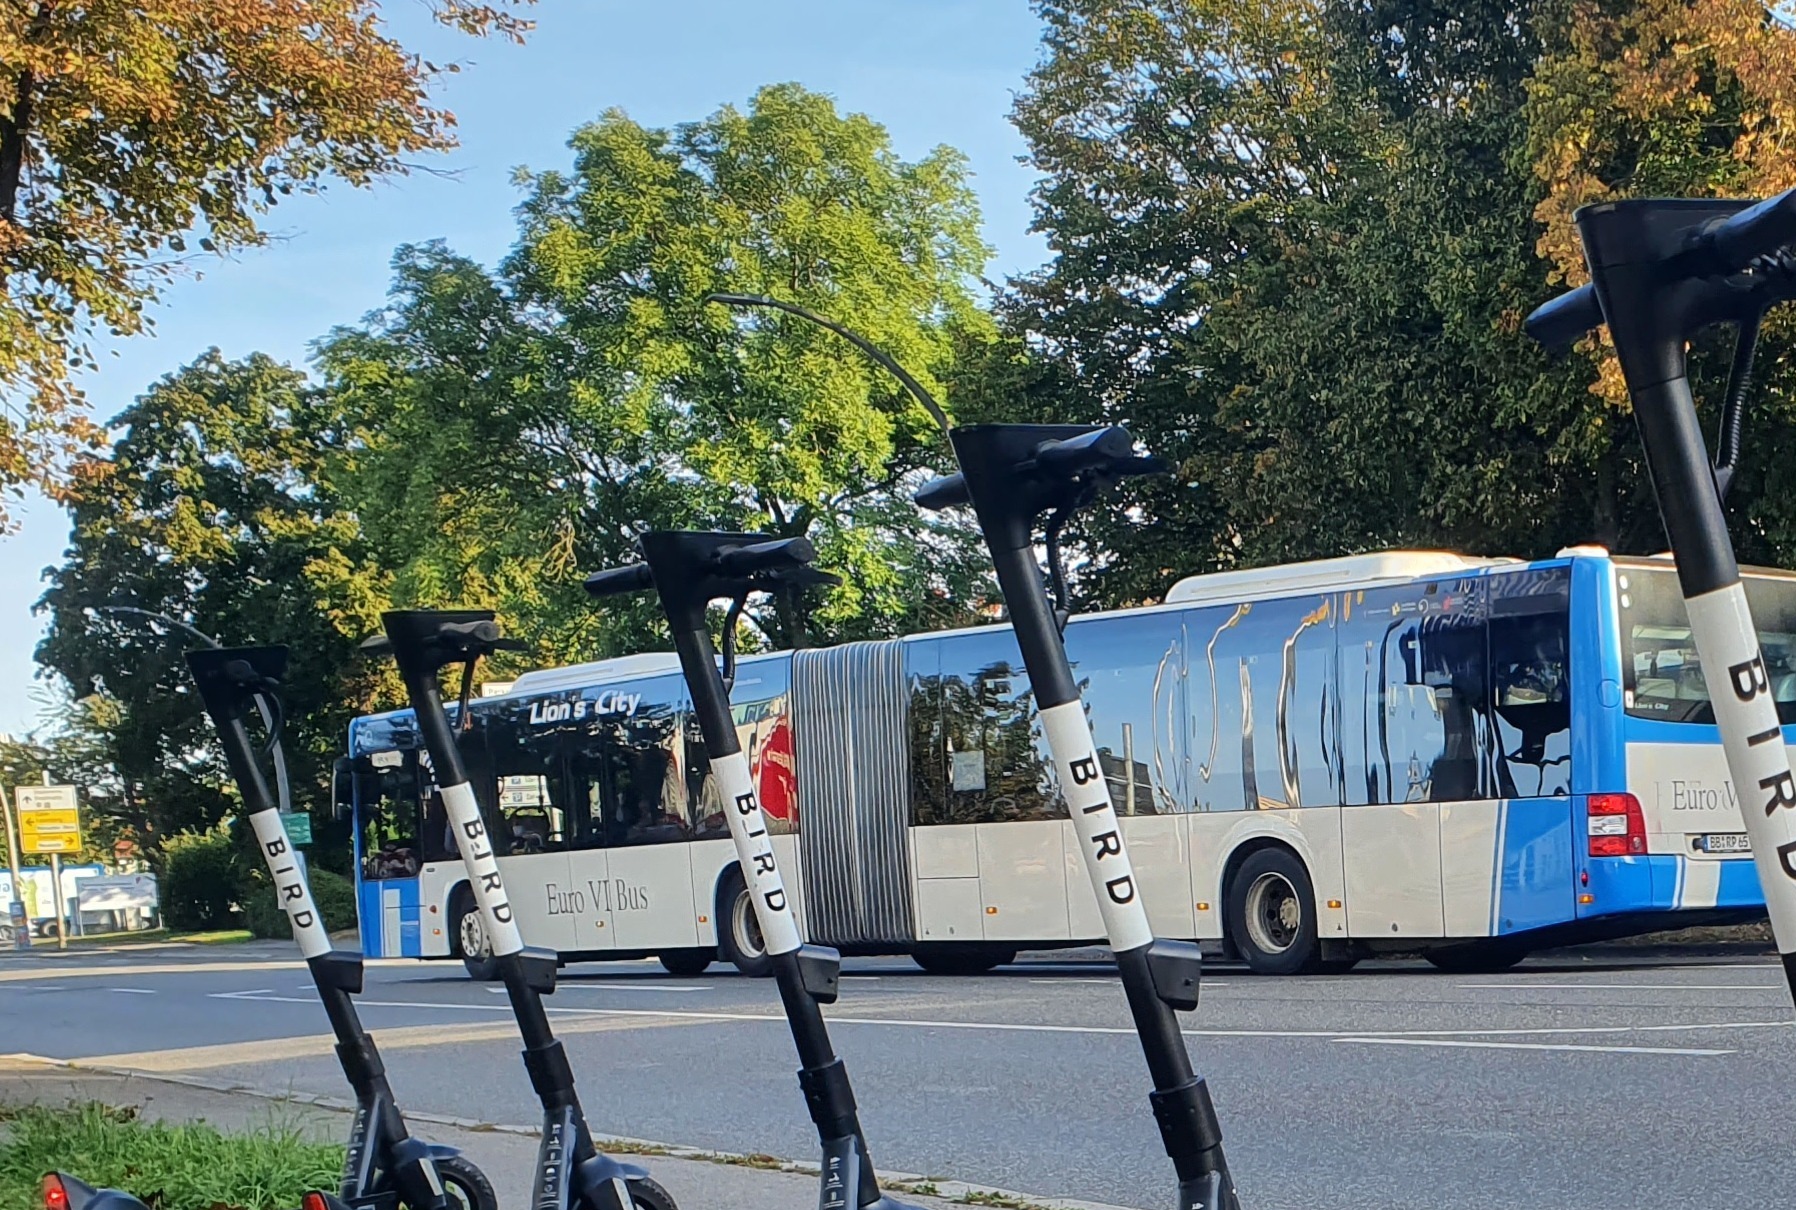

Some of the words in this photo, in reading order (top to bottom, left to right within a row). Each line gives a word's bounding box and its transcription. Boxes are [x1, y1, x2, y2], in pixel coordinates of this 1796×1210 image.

[529, 695, 588, 725] Lion's
[594, 689, 641, 717] City
[1671, 780, 1718, 811] Euro
[1723, 780, 1740, 809] V
[735, 791, 786, 912] BIRD
[1069, 756, 1135, 904] BIRD
[1738, 836, 1750, 848] 65
[265, 836, 314, 929] BIRD
[463, 818, 512, 924] BIRD
[546, 883, 585, 915] Euro
[587, 880, 613, 912] VI
[615, 879, 649, 911] Bus
